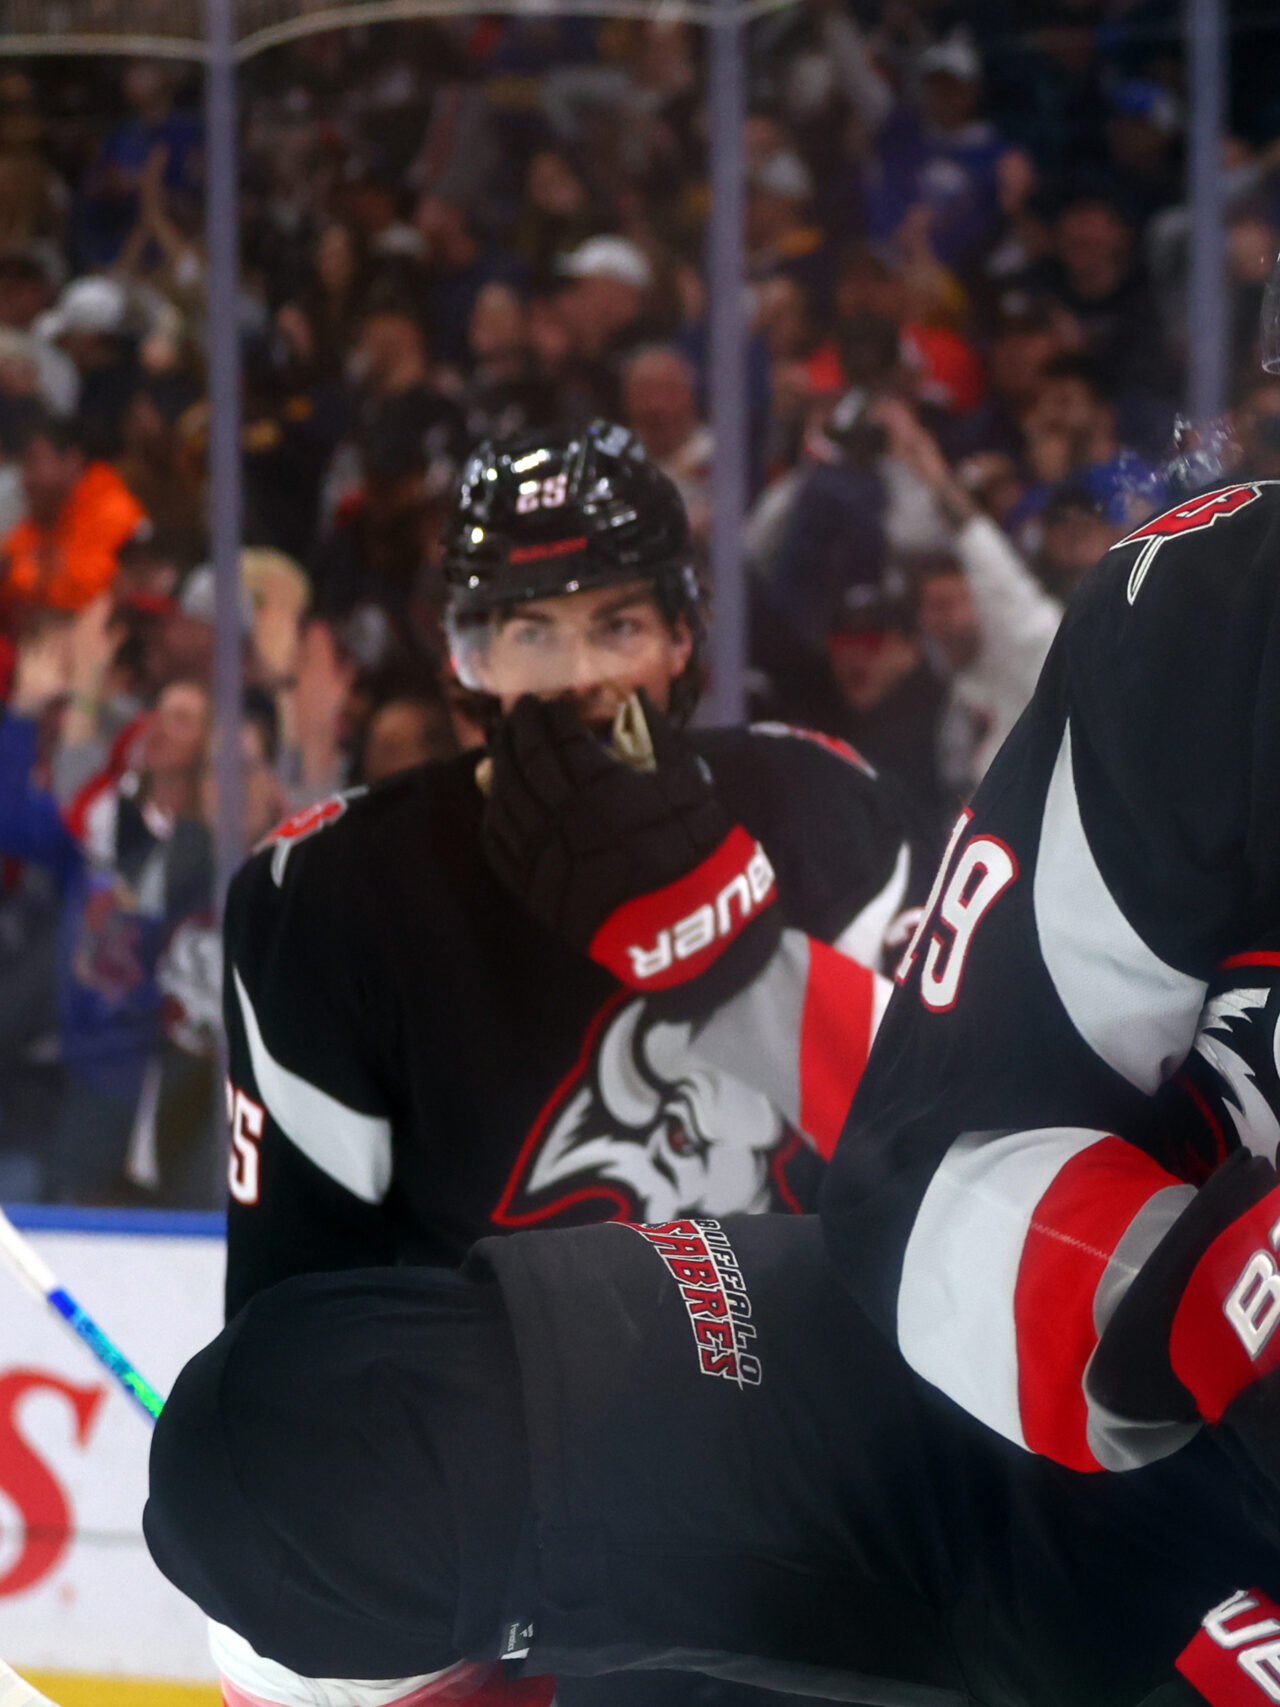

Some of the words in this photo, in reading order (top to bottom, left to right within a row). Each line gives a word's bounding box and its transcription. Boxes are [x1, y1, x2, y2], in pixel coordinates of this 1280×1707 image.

[225, 1074, 267, 1207] 5
[628, 1218, 744, 1382] SABRES
[692, 1219, 763, 1386] BUFFALO
